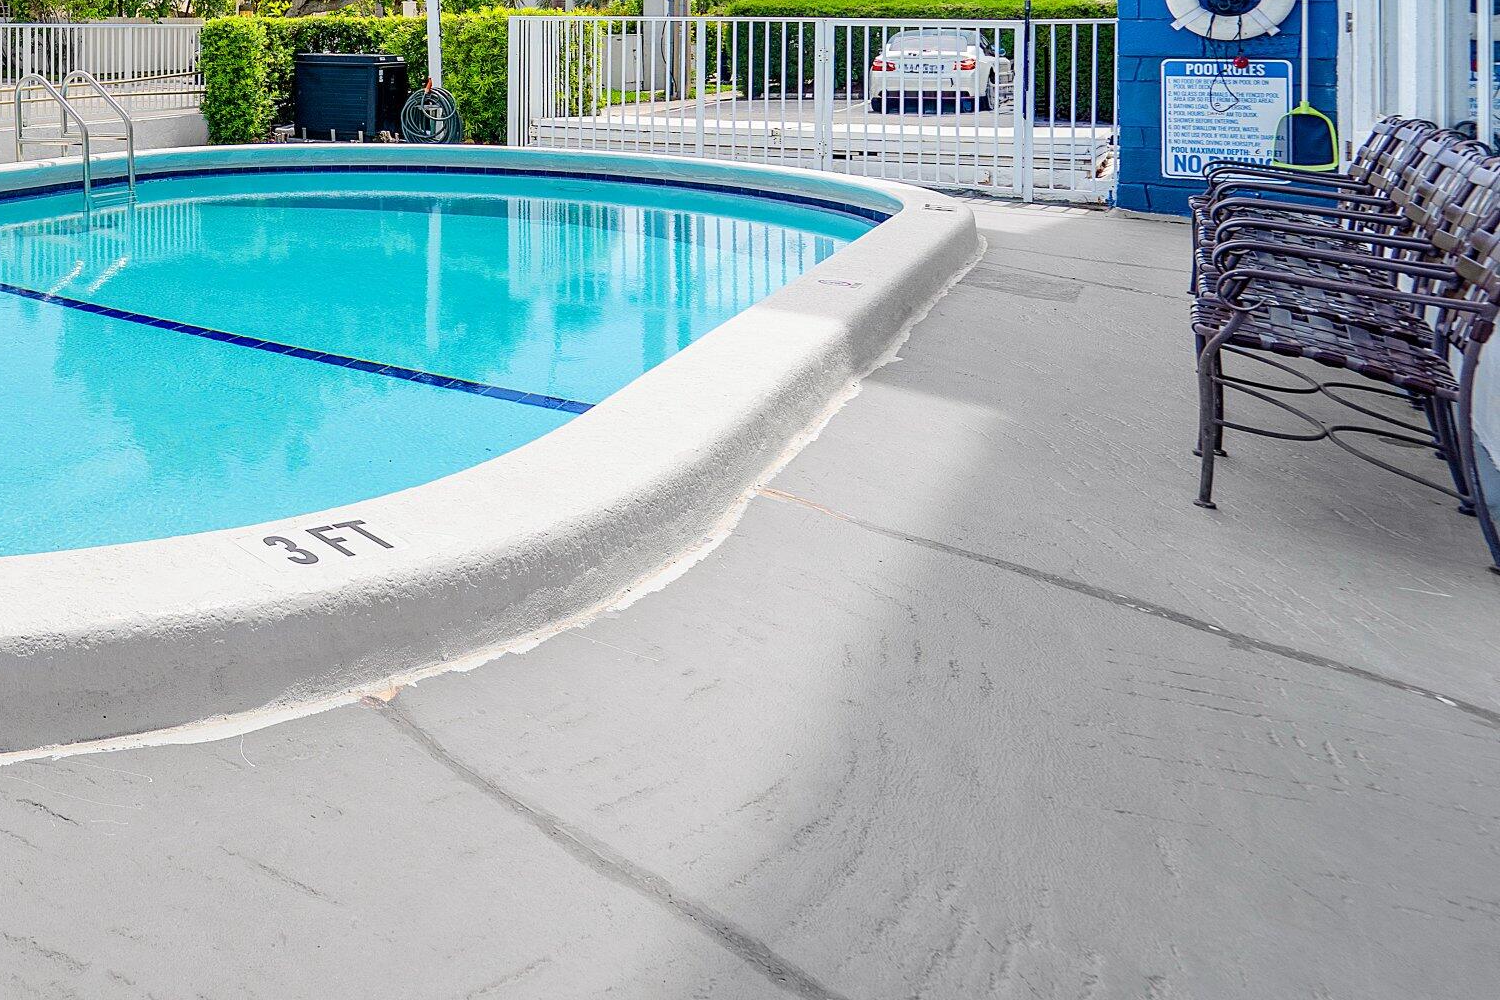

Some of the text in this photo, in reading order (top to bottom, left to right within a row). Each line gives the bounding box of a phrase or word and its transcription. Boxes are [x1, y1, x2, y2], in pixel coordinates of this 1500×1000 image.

[1186, 64, 1266, 76] POOL RULES
[1174, 154, 1201, 173] NO
[262, 520, 394, 565] 3 FT
